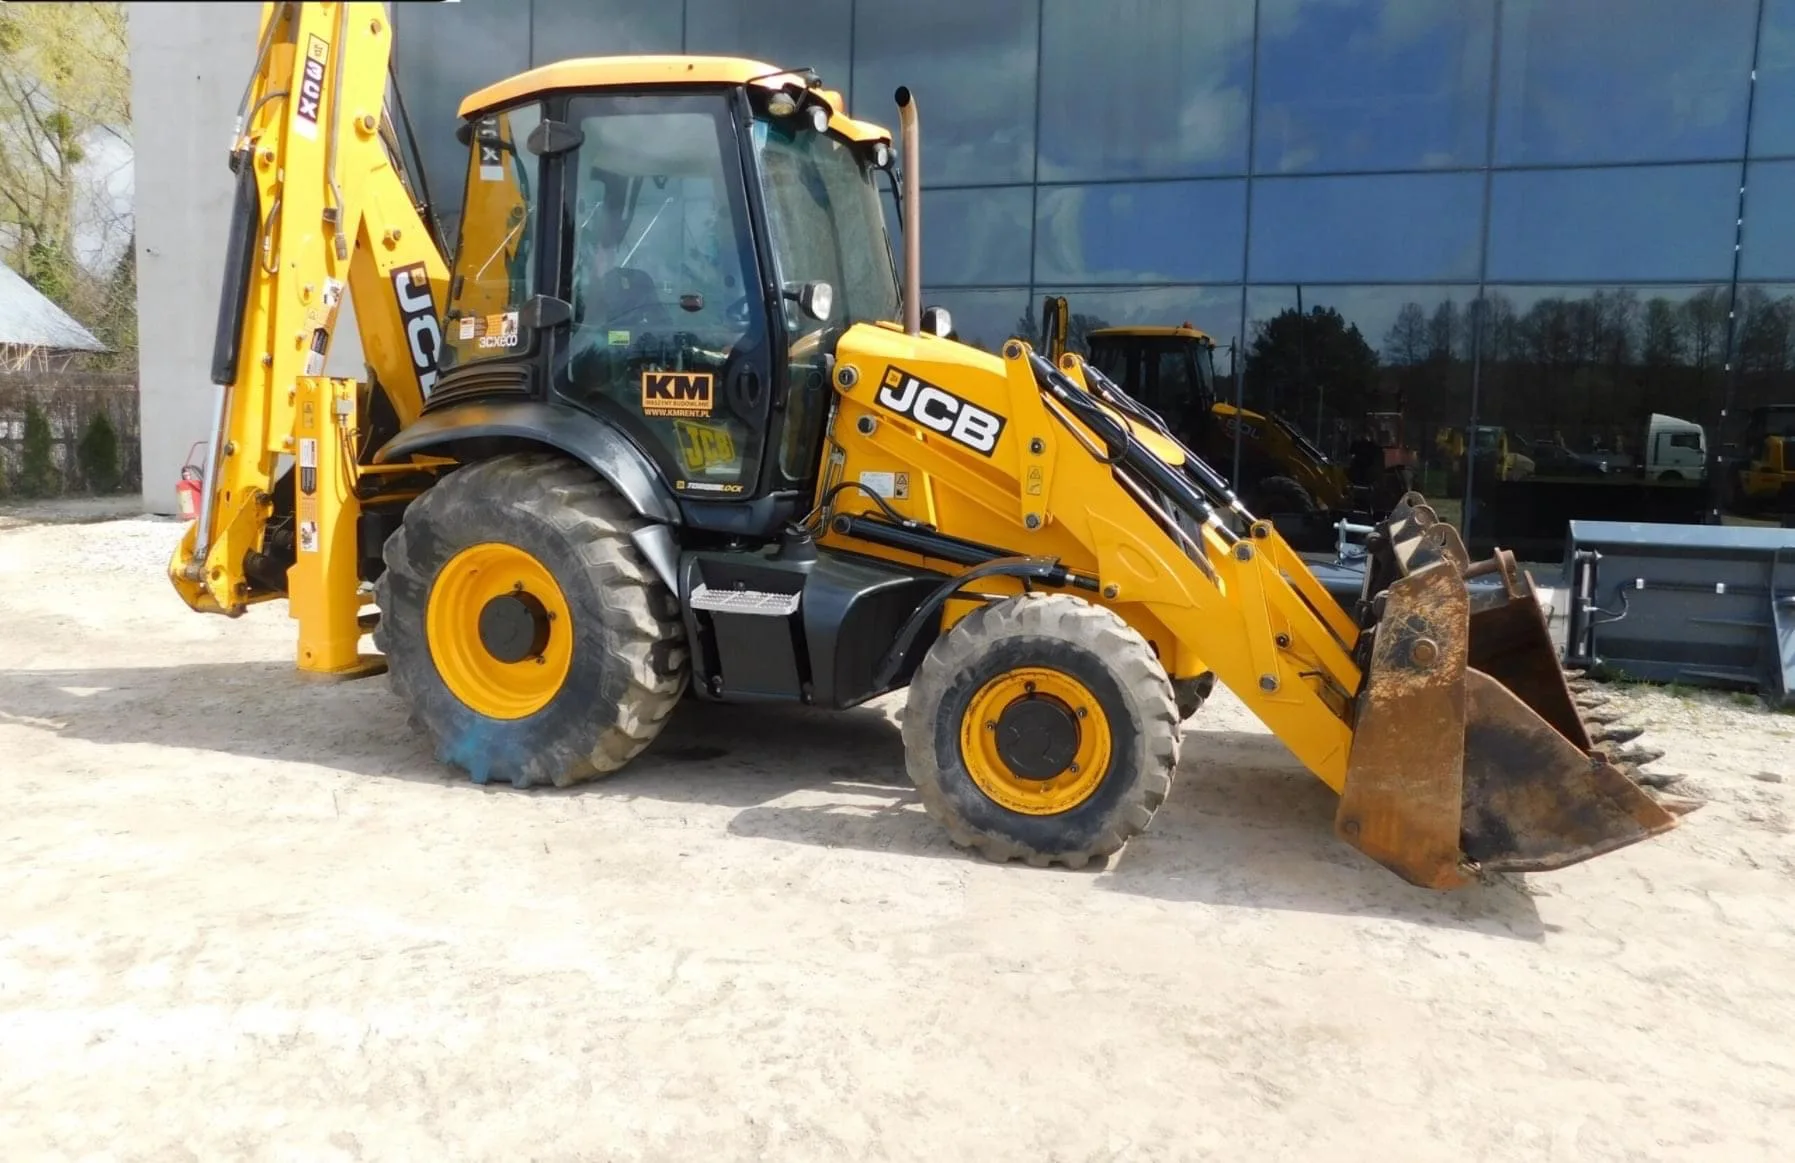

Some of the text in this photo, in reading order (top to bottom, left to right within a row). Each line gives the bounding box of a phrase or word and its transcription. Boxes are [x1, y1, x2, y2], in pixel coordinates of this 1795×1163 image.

[646, 374, 709, 400] KM
[645, 408, 711, 417] WWW.KMRENT.PL
[879, 378, 1000, 452] JCB
